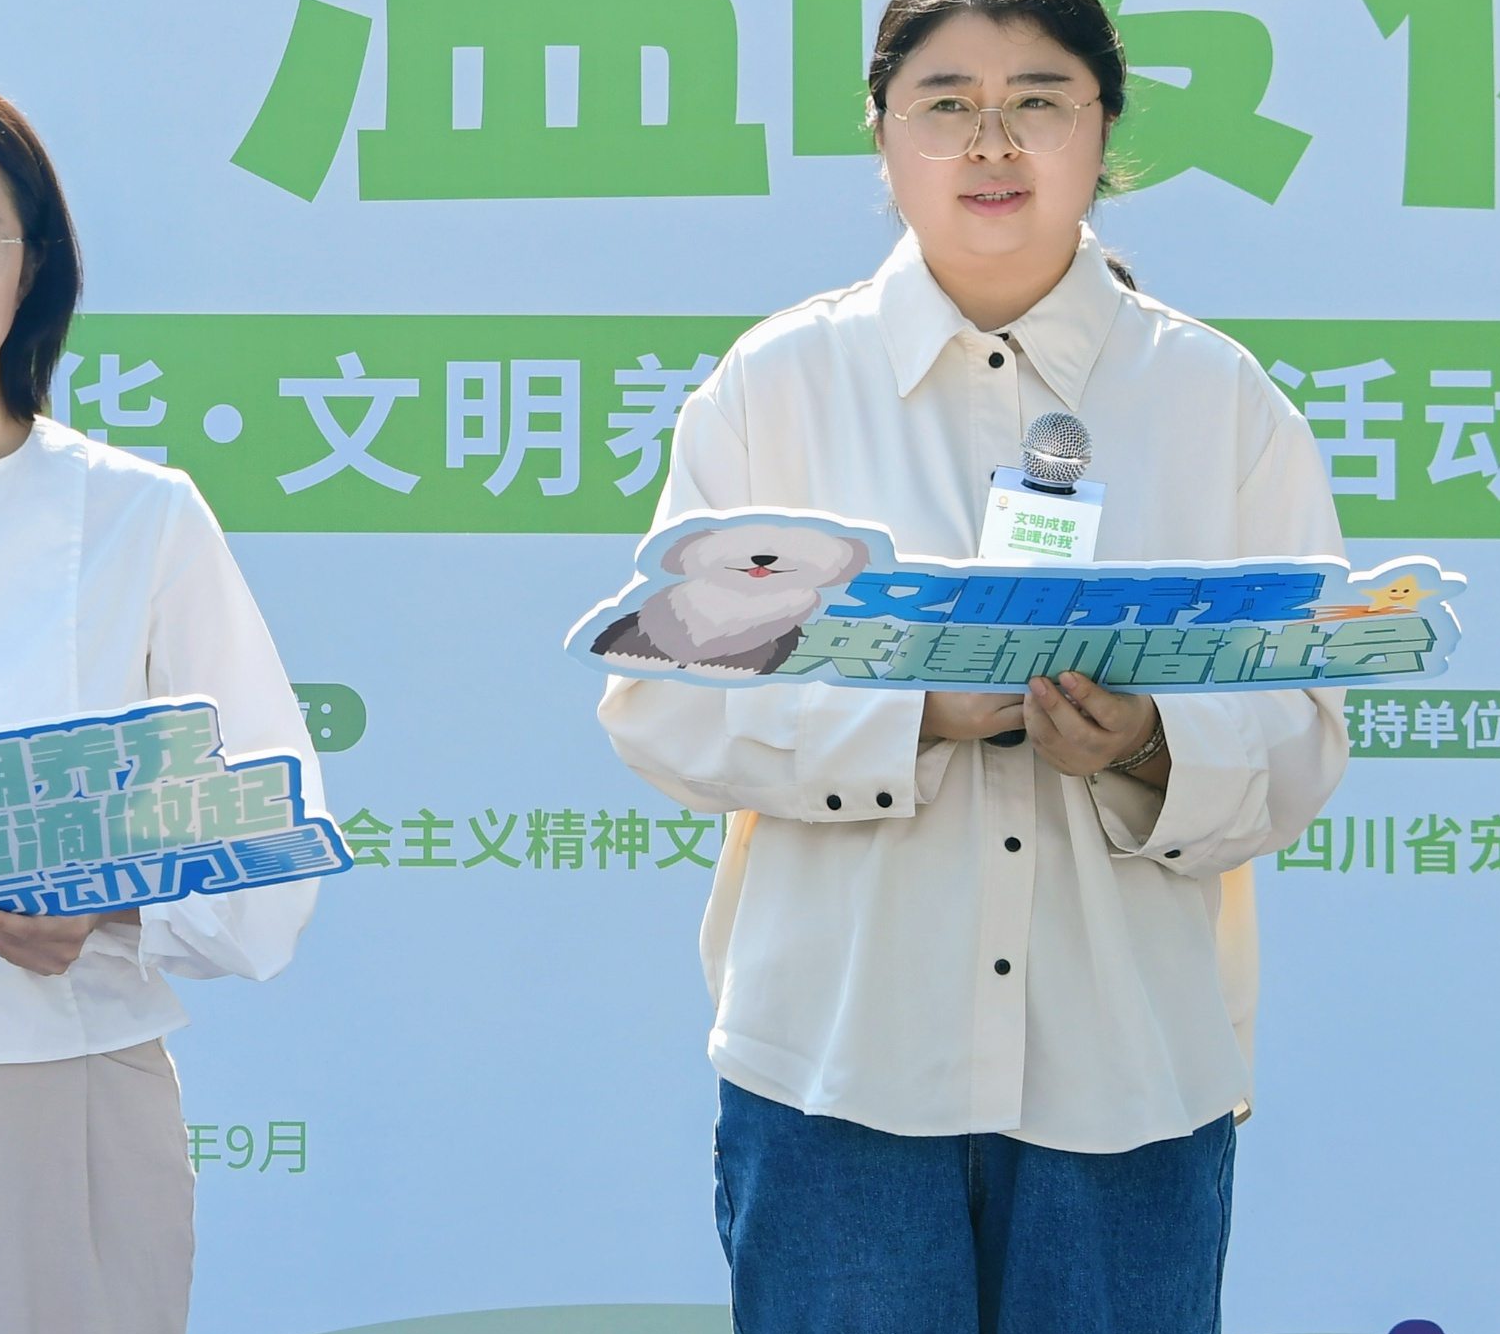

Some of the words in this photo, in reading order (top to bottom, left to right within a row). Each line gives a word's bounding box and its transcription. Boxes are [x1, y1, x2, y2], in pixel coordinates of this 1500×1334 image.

[1014, 511, 1076, 534] 文明成都
[825, 570, 1326, 626] 文明养宠
[785, 616, 1437, 686] 共建和谐社会
